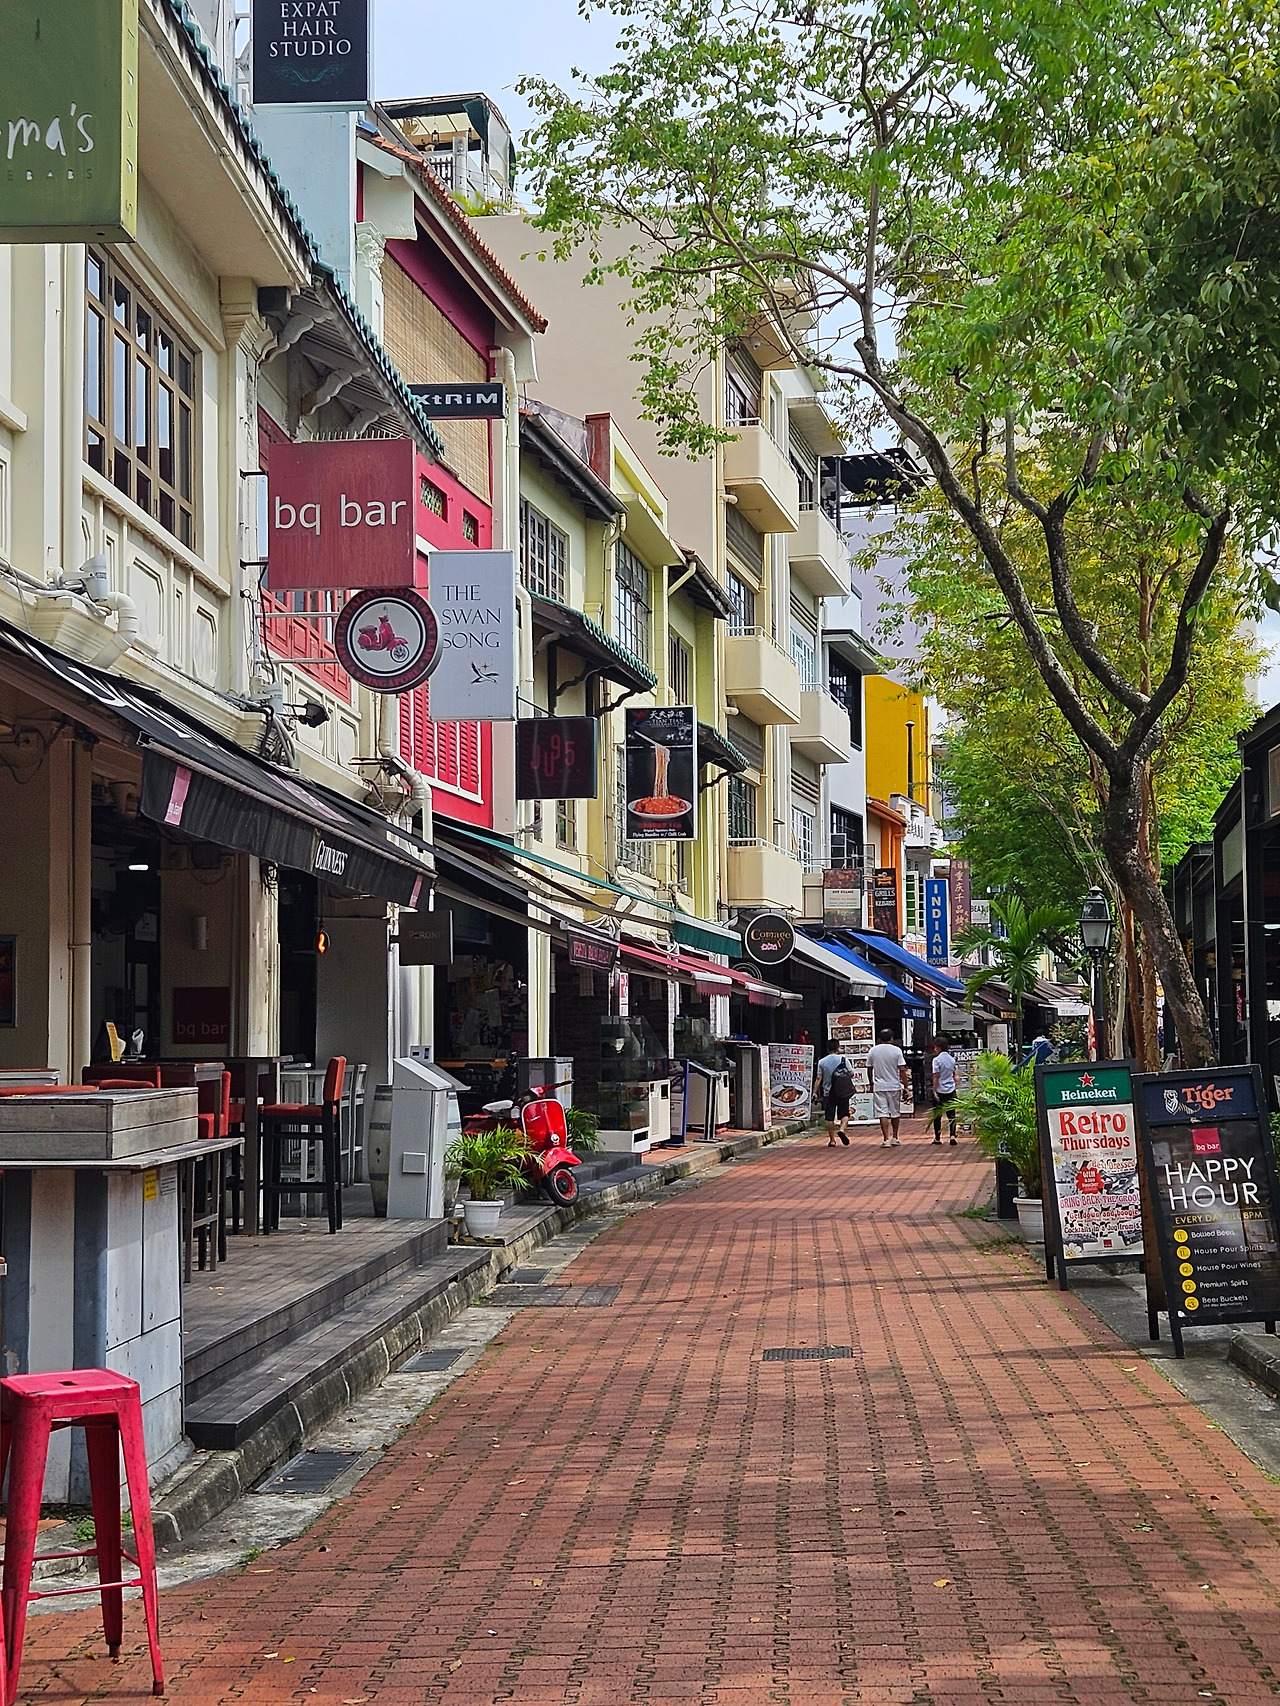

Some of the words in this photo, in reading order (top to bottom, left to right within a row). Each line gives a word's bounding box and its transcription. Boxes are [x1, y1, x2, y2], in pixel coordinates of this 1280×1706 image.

[281, 1, 341, 18] EXPAT
[283, 20, 338, 36] HAIR
[269, 39, 352, 57] STUDIO
[0, 102, 94, 160] ma's
[275, 496, 321, 535] bq
[340, 494, 407, 527] bar
[442, 585, 481, 602] THE
[441, 609, 501, 626] SWAN
[443, 632, 500, 649] SONG
[362, 668, 420, 688] SINGAPORE
[931, 884, 942, 955] INDIAN
[928, 957, 948, 966] HOUSE
[176, 1020, 196, 1038] bq
[201, 1020, 228, 1035] bar
[1061, 1087, 1117, 1100] Heineken
[1182, 1084, 1234, 1109] Tiger
[1059, 1111, 1126, 1136] Retro
[1059, 1135, 1131, 1151] Thursdays
[1109, 1159, 1136, 1170] Dressed
[1165, 1157, 1254, 1185] HAPPY
[1060, 1195, 1080, 1208] BRING
[1082, 1195, 1100, 1206] BACK
[1102, 1195, 1117, 1204] THE
[1169, 1182, 1260, 1210] HOUR
[1103, 1209, 1115, 1217] and
[1117, 1208, 1138, 1216] boogie
[1175, 1215, 1202, 1224] EVERY
[1243, 1211, 1263, 1220] 8PM
[1064, 1225, 1091, 1233] Cocktails
[1191, 1231, 1215, 1239] Bottled
[1240, 1245, 1263, 1253] Spirits
[1197, 1264, 1219, 1272] House
[1200, 1281, 1229, 1289] Premium
[1230, 1279, 1249, 1288] Spirits
[1220, 1294, 1248, 1303] Buckets
